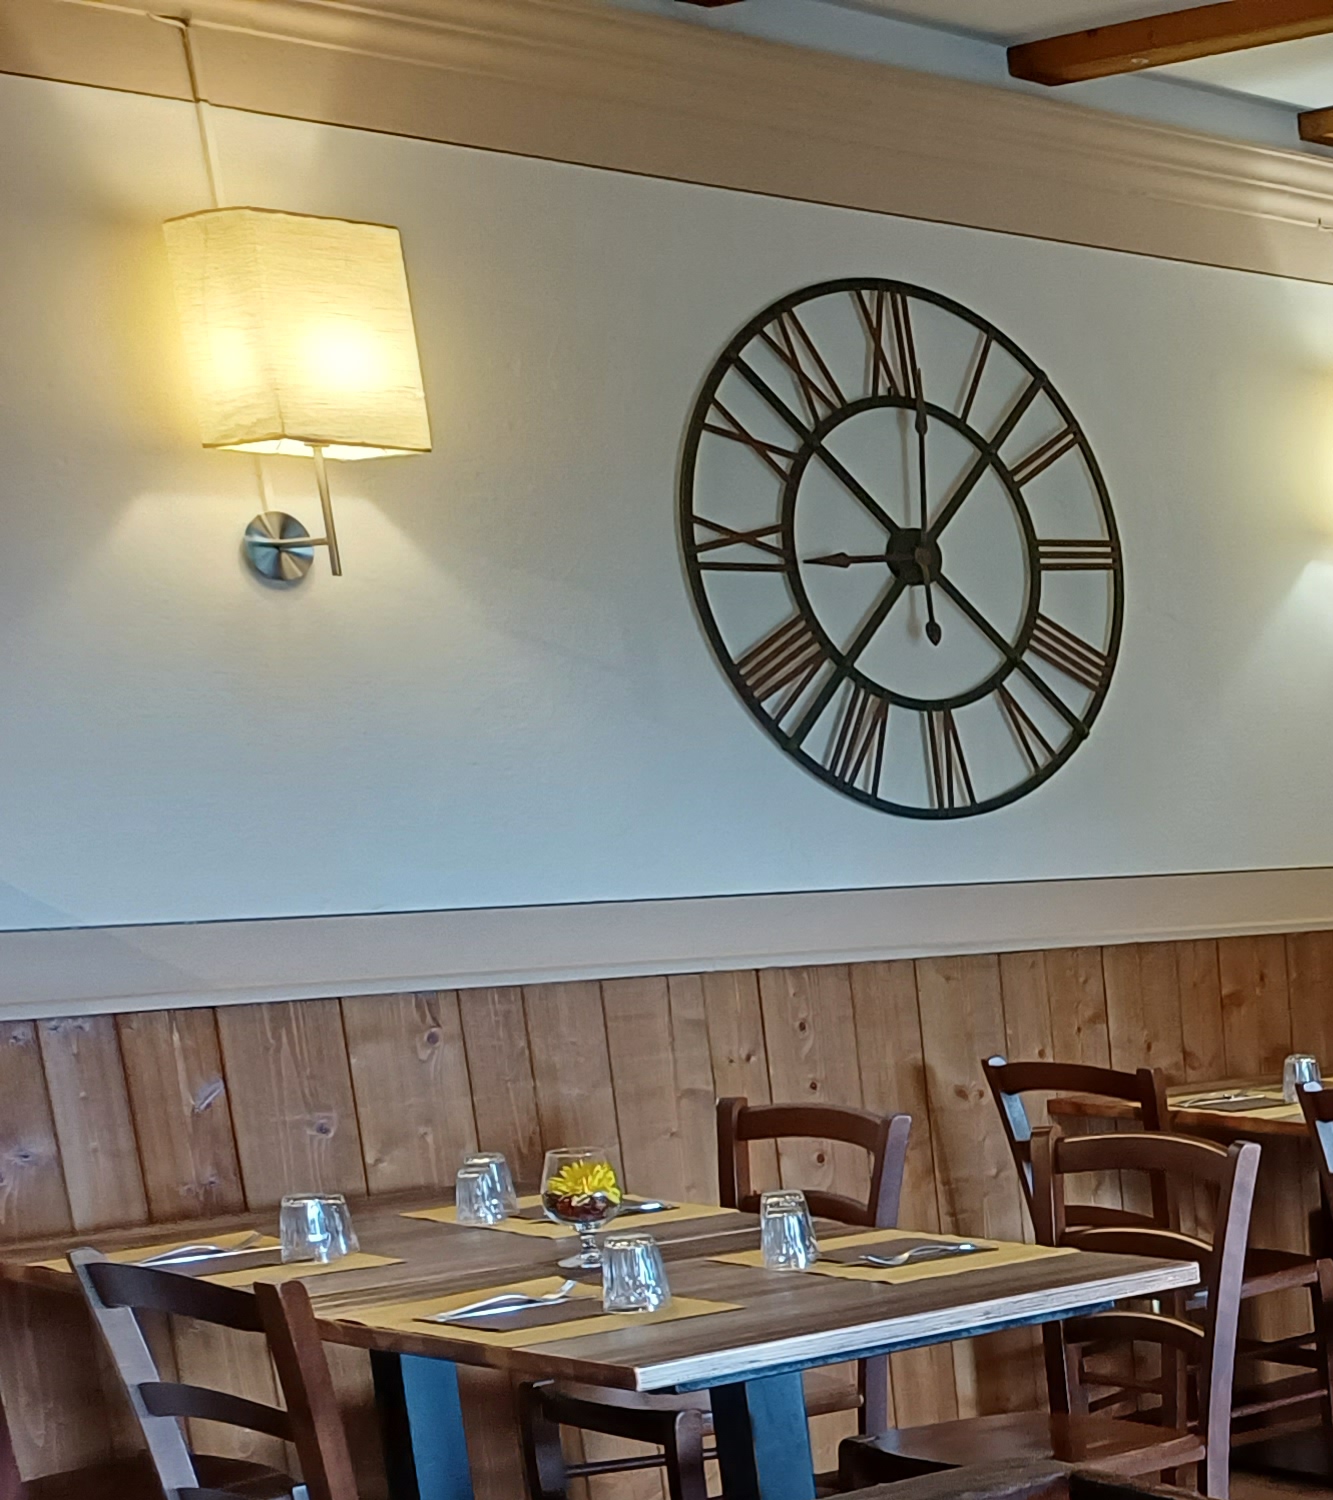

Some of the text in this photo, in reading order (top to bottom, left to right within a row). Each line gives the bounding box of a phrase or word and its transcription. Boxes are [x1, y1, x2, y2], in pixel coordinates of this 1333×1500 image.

[759, 308, 847, 423] XI
[703, 397, 800, 485] X
[692, 514, 786, 572] IX
[1038, 539, 1115, 571] III
[1027, 612, 1108, 692] IIII
